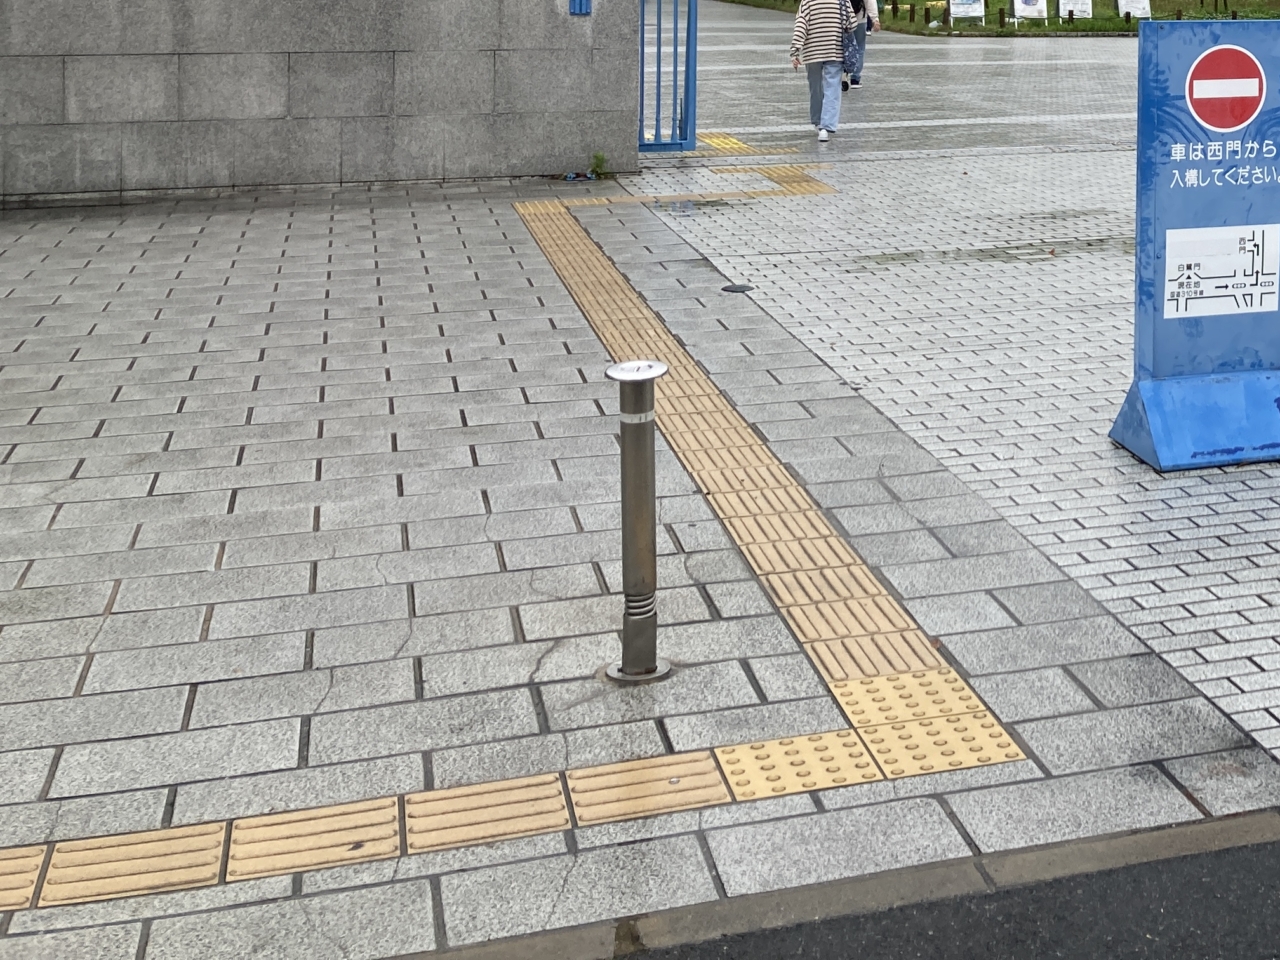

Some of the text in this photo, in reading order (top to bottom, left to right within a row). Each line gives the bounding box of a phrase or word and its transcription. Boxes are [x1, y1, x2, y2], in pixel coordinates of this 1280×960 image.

[1170, 140, 1277, 163] 車は西門から
[1238, 237, 1246, 255] 西門
[1178, 280, 1201, 290] 現在地
